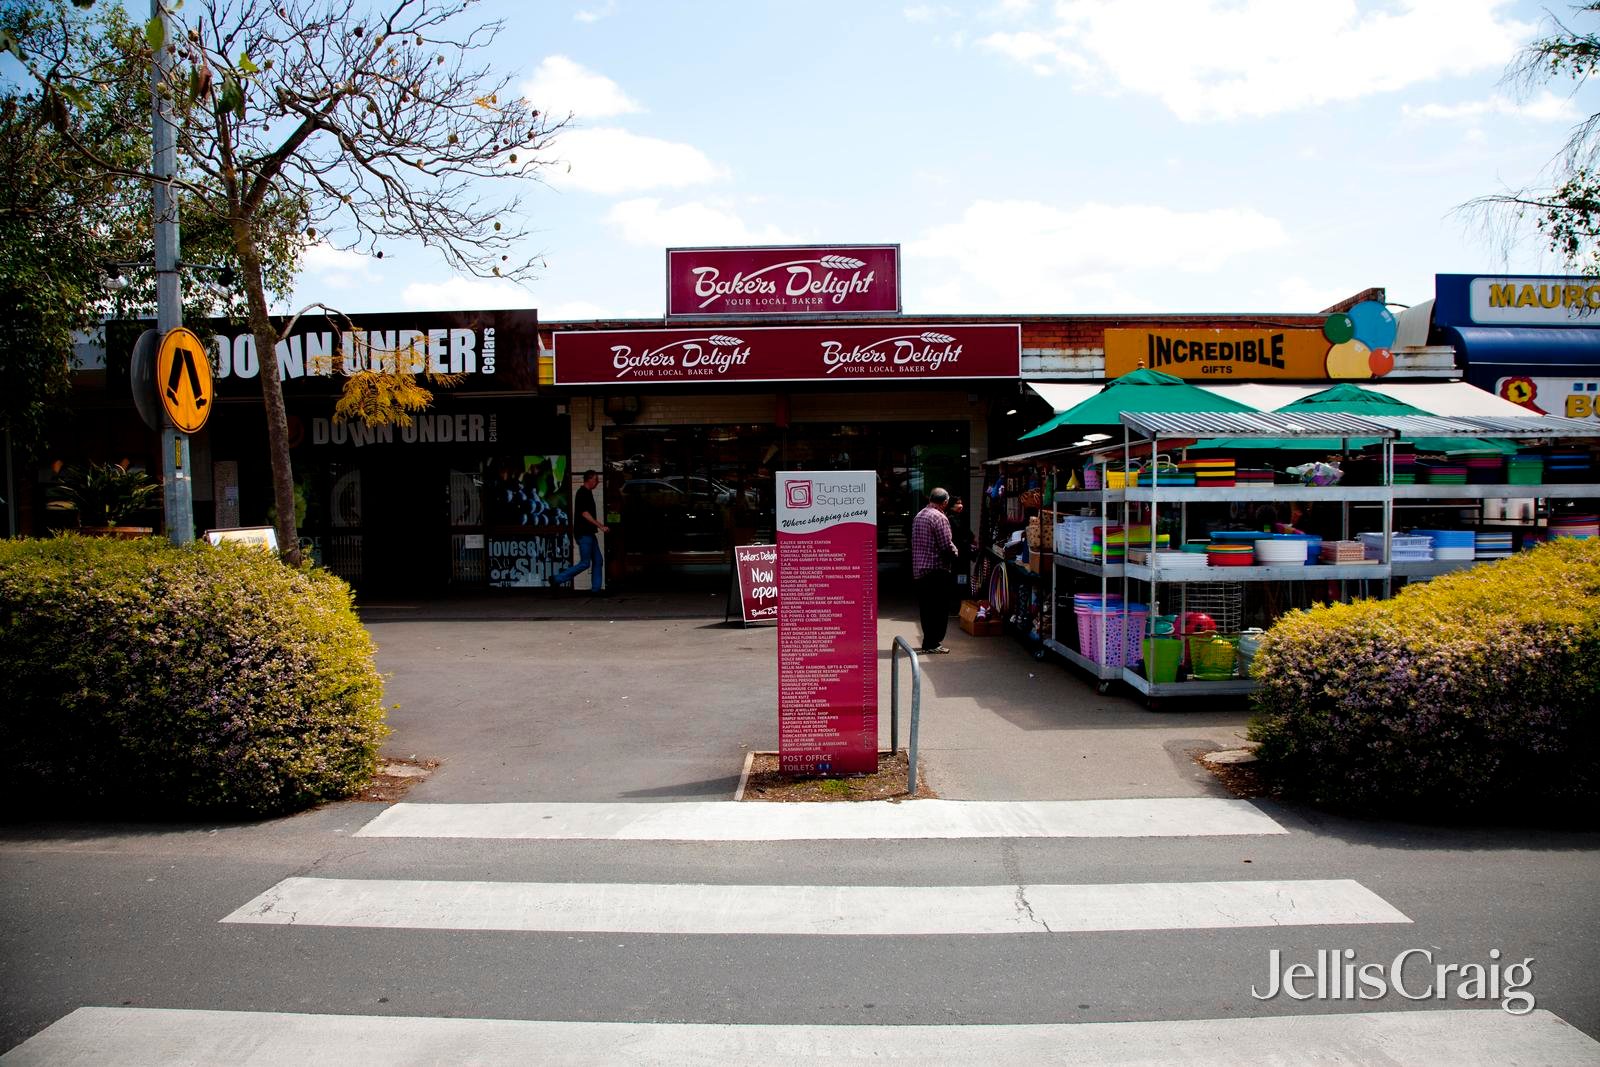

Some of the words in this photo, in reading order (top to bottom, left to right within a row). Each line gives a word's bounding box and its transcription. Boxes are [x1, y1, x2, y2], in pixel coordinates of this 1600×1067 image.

[692, 266, 776, 308] Bakers
[785, 265, 875, 304] Delight
[725, 298, 751, 306] YOUR
[755, 298, 787, 306] LOCAL
[791, 297, 823, 305] BAKER
[342, 328, 477, 374] UNDER
[482, 327, 495, 375] Cellars
[820, 340, 886, 374] Bakers
[894, 340, 963, 371] Delight
[1148, 333, 1285, 369] INCREDIBLE
[610, 345, 675, 377] Bakers
[682, 343, 751, 373] Delight
[633, 369, 654, 377] YOUR
[688, 368, 713, 376] BAKER
[869, 365, 894, 373] LOCAL
[899, 365, 925, 373] BAKER
[1201, 365, 1233, 374] GIFTS
[312, 418, 393, 448] DOWN
[402, 414, 485, 443] UNDER
[816, 482, 866, 493] Tunstall
[816, 494, 865, 507] Square
[782, 518, 807, 528] Where
[808, 513, 841, 525] shopping
[850, 509, 868, 518] easy
[740, 550, 759, 562] Bakers
[760, 549, 777, 563] Deligh
[751, 567, 774, 583] Now
[752, 586, 777, 606] open
